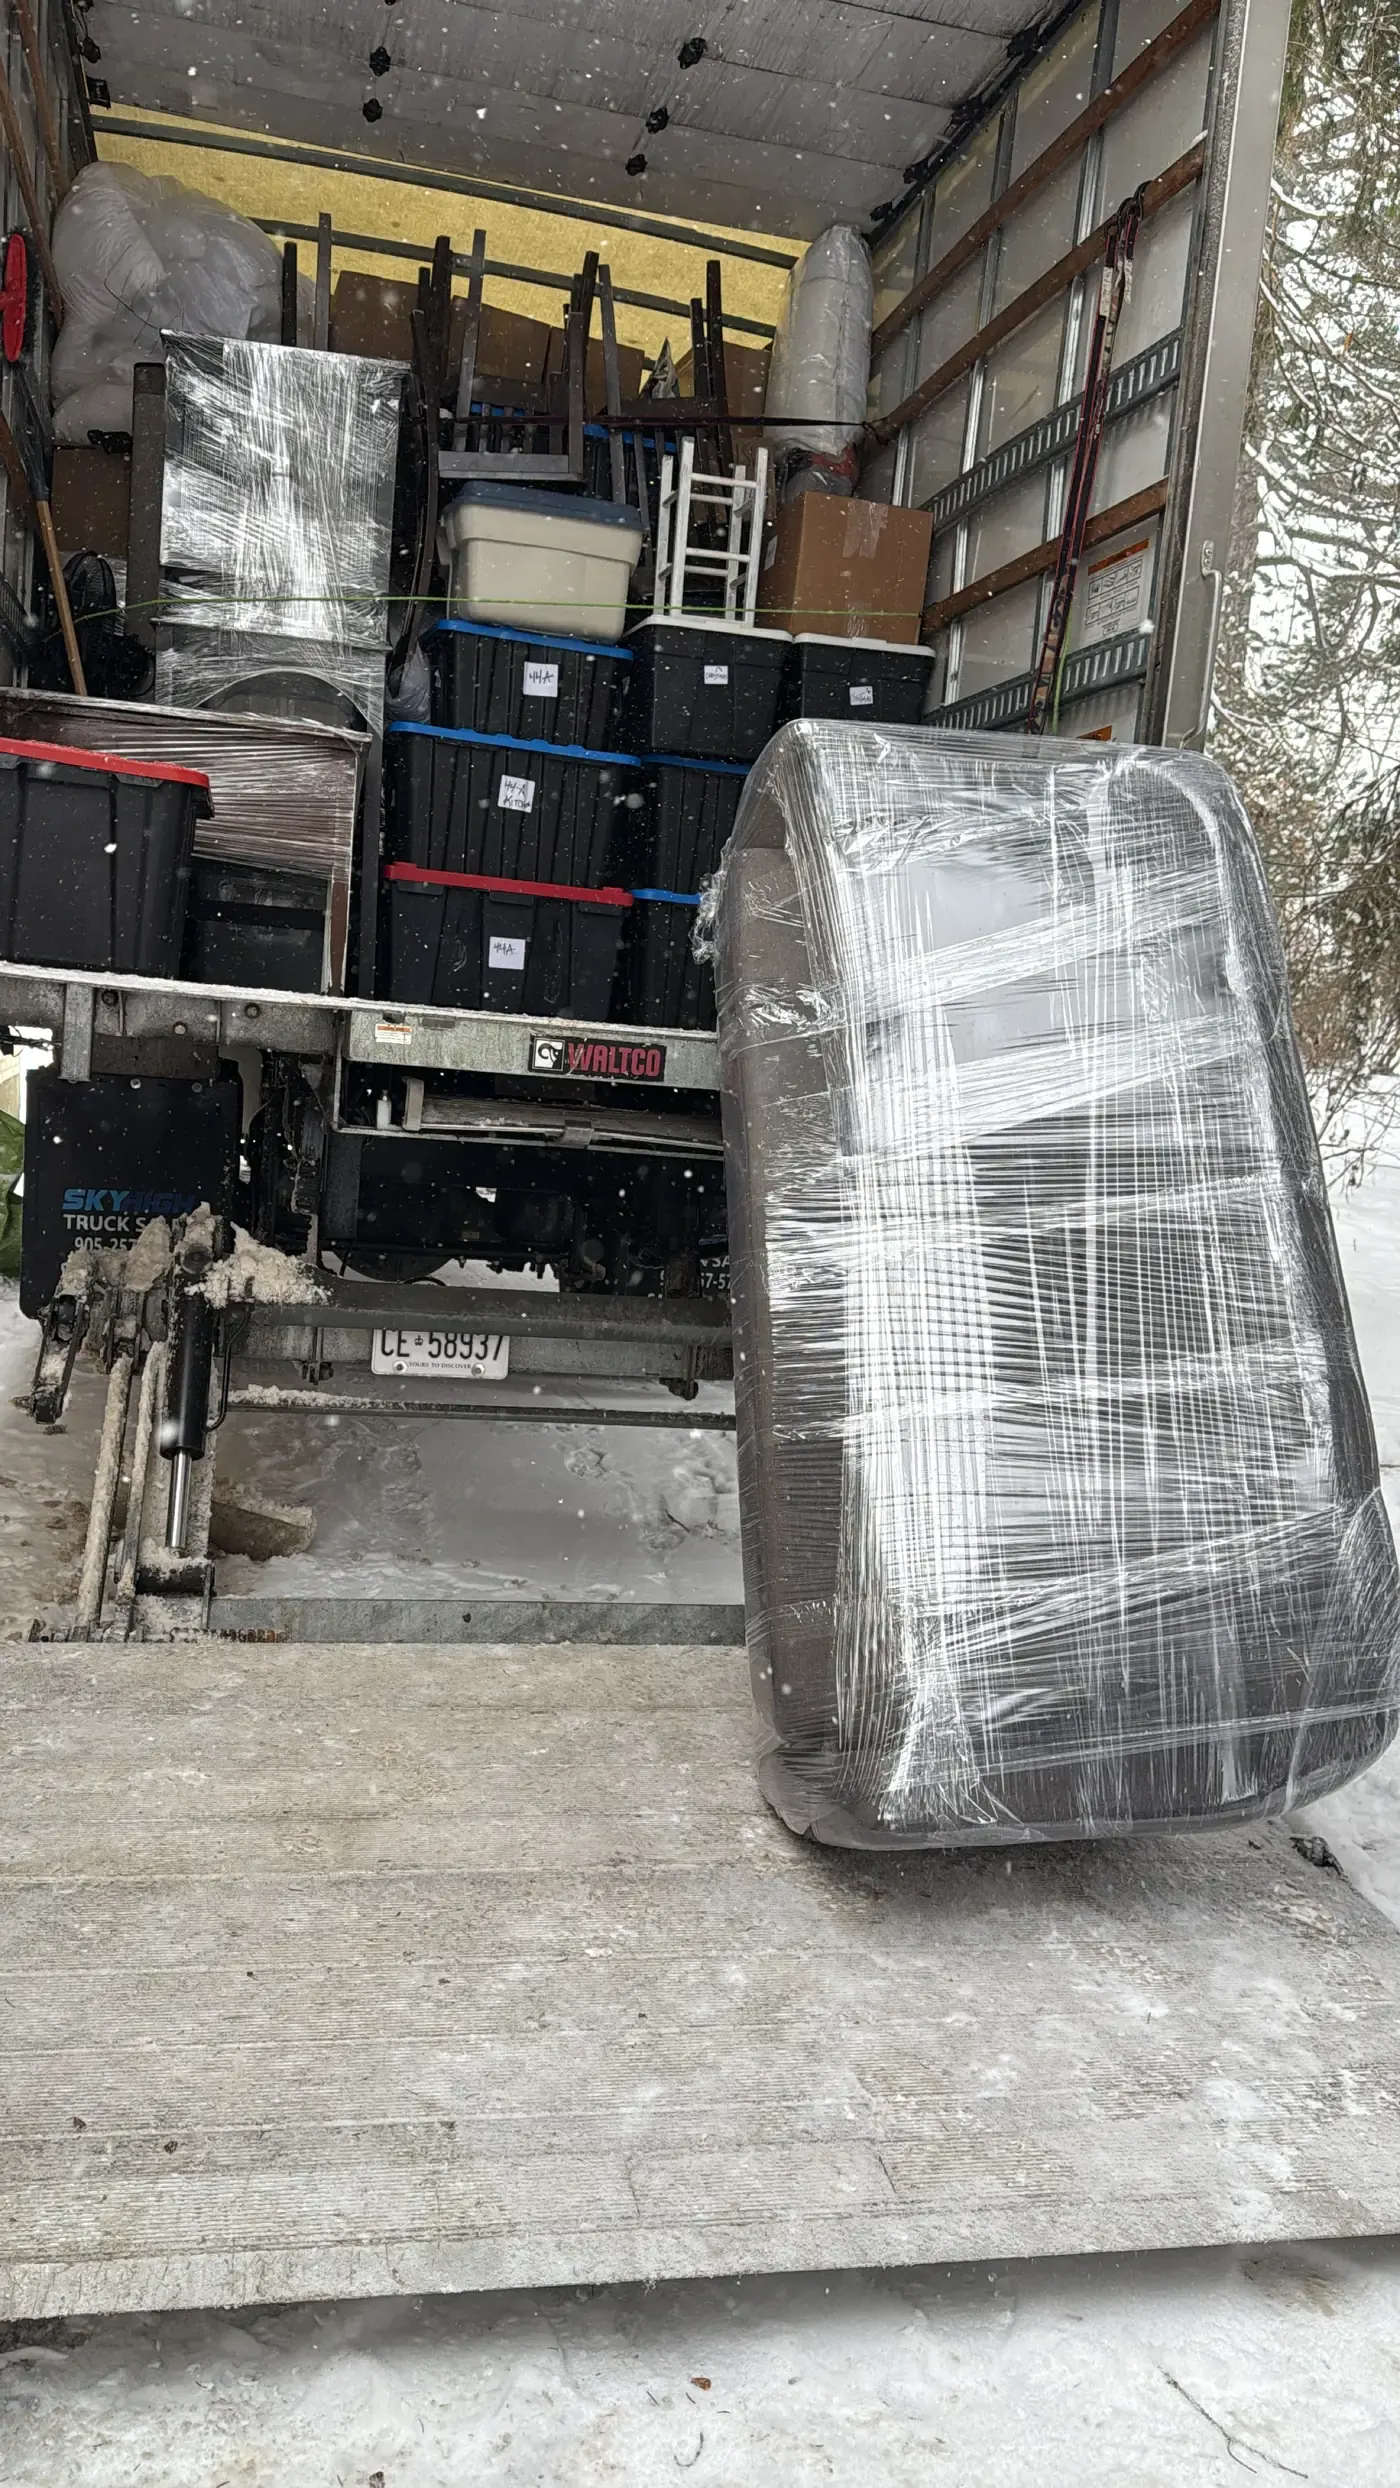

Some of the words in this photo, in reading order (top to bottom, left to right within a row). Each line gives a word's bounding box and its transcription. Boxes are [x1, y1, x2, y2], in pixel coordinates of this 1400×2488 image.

[568, 1043, 661, 1077] WALTCO
[63, 1214, 130, 1232] TRUCK
[74, 1236, 138, 1251] 905-257
[427, 1332, 503, 1361] 58937
